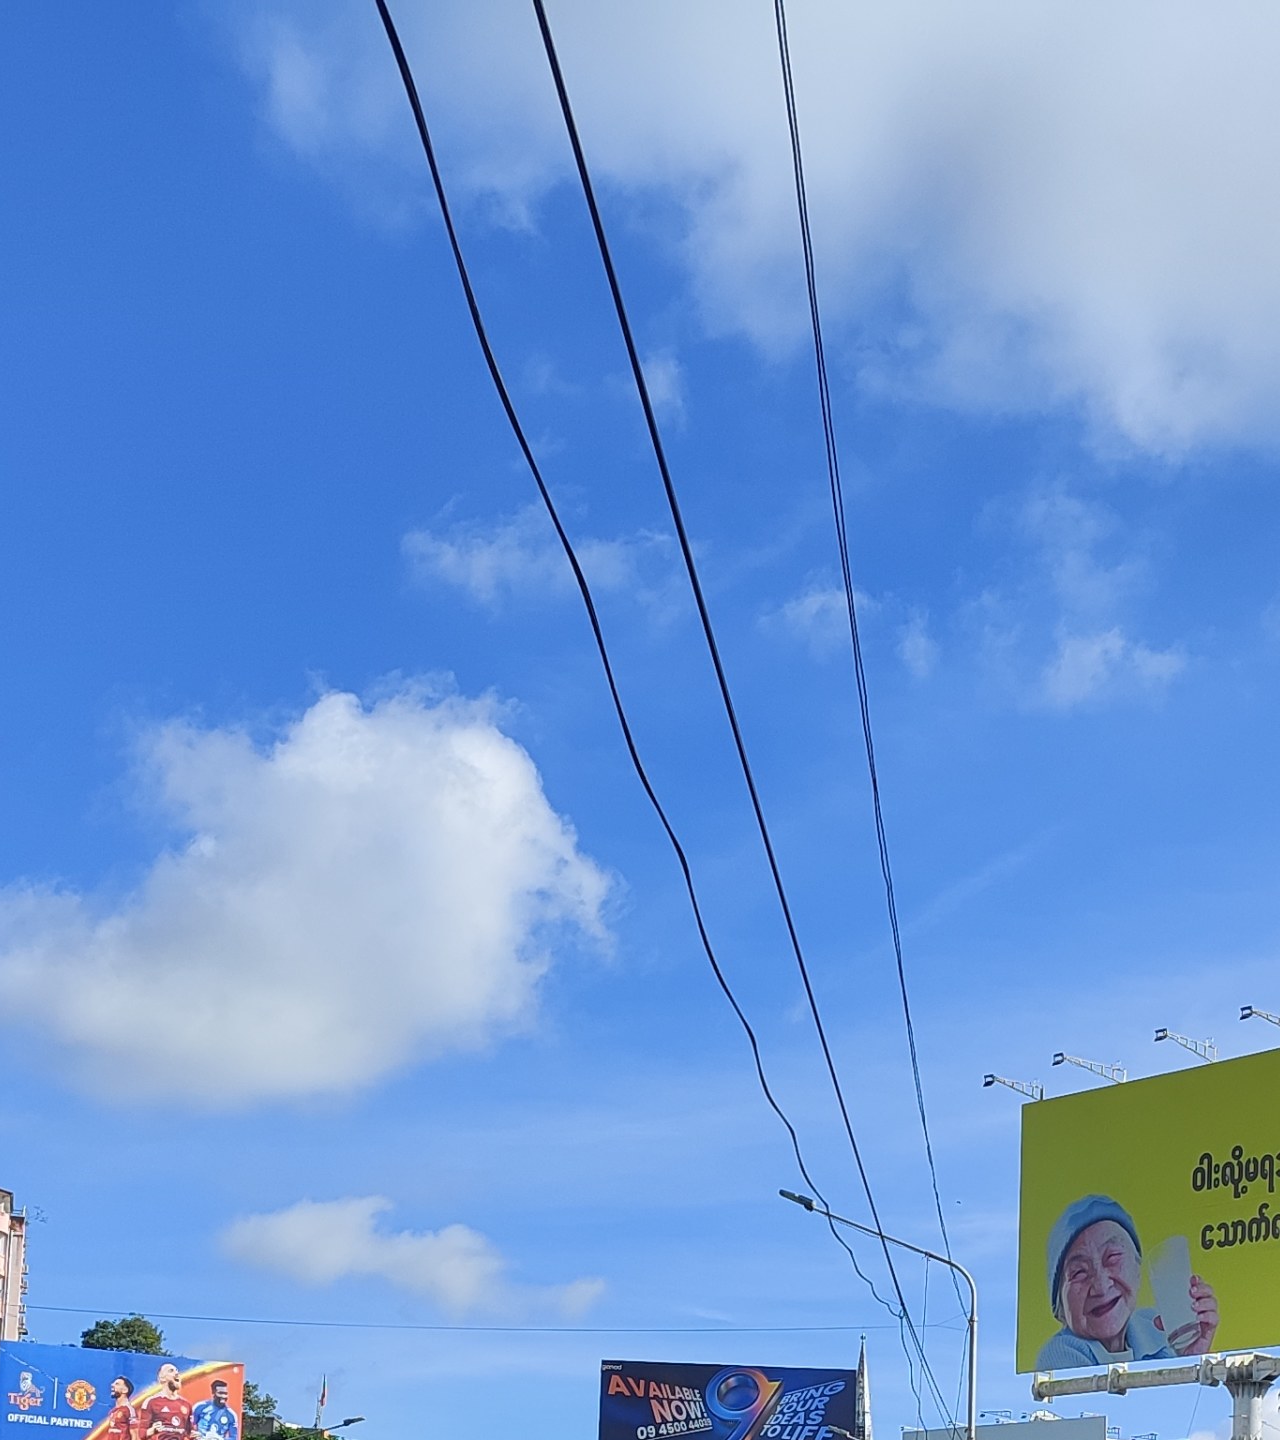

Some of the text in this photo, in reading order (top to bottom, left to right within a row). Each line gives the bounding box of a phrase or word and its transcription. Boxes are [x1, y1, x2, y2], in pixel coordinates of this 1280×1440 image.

[607, 1374, 703, 1401] AVAILABLE
[779, 1381, 846, 1405] BRING
[7, 1392, 44, 1411] Tiger
[775, 1396, 830, 1414] YOUR
[7, 1413, 94, 1429] OFFICIAL PARTNER
[649, 1399, 708, 1424] NOW!
[765, 1410, 826, 1425] IDEAS
[636, 1425, 656, 1440] 09
[658, 1420, 688, 1435] 4500
[759, 1424, 782, 1437] TO
